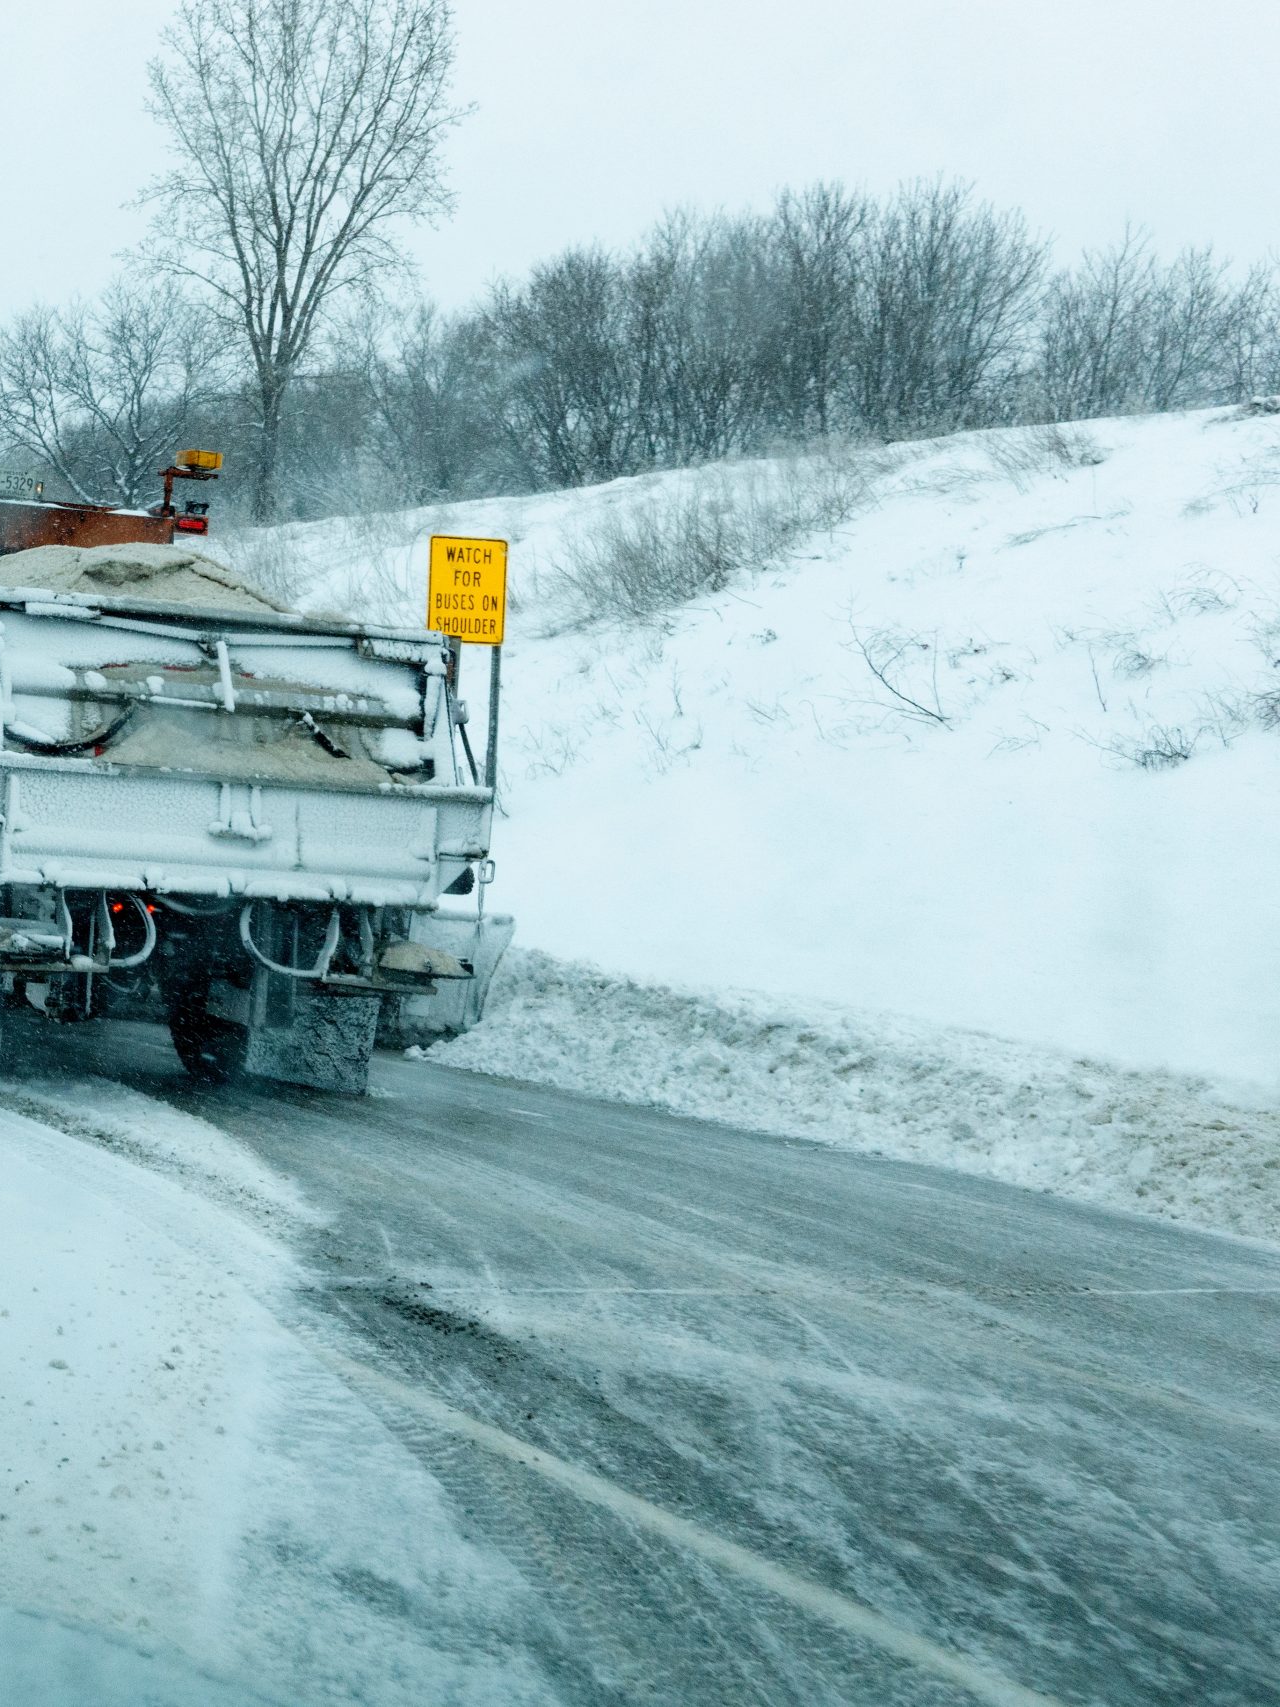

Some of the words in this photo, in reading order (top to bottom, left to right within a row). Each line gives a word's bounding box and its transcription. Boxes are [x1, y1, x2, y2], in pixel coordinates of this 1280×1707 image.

[446, 546, 492, 565] WATCH
[454, 570, 482, 587] FOR
[435, 593, 475, 611] BUSES
[482, 595, 498, 612] ON
[435, 616, 497, 635] SHOULDER
